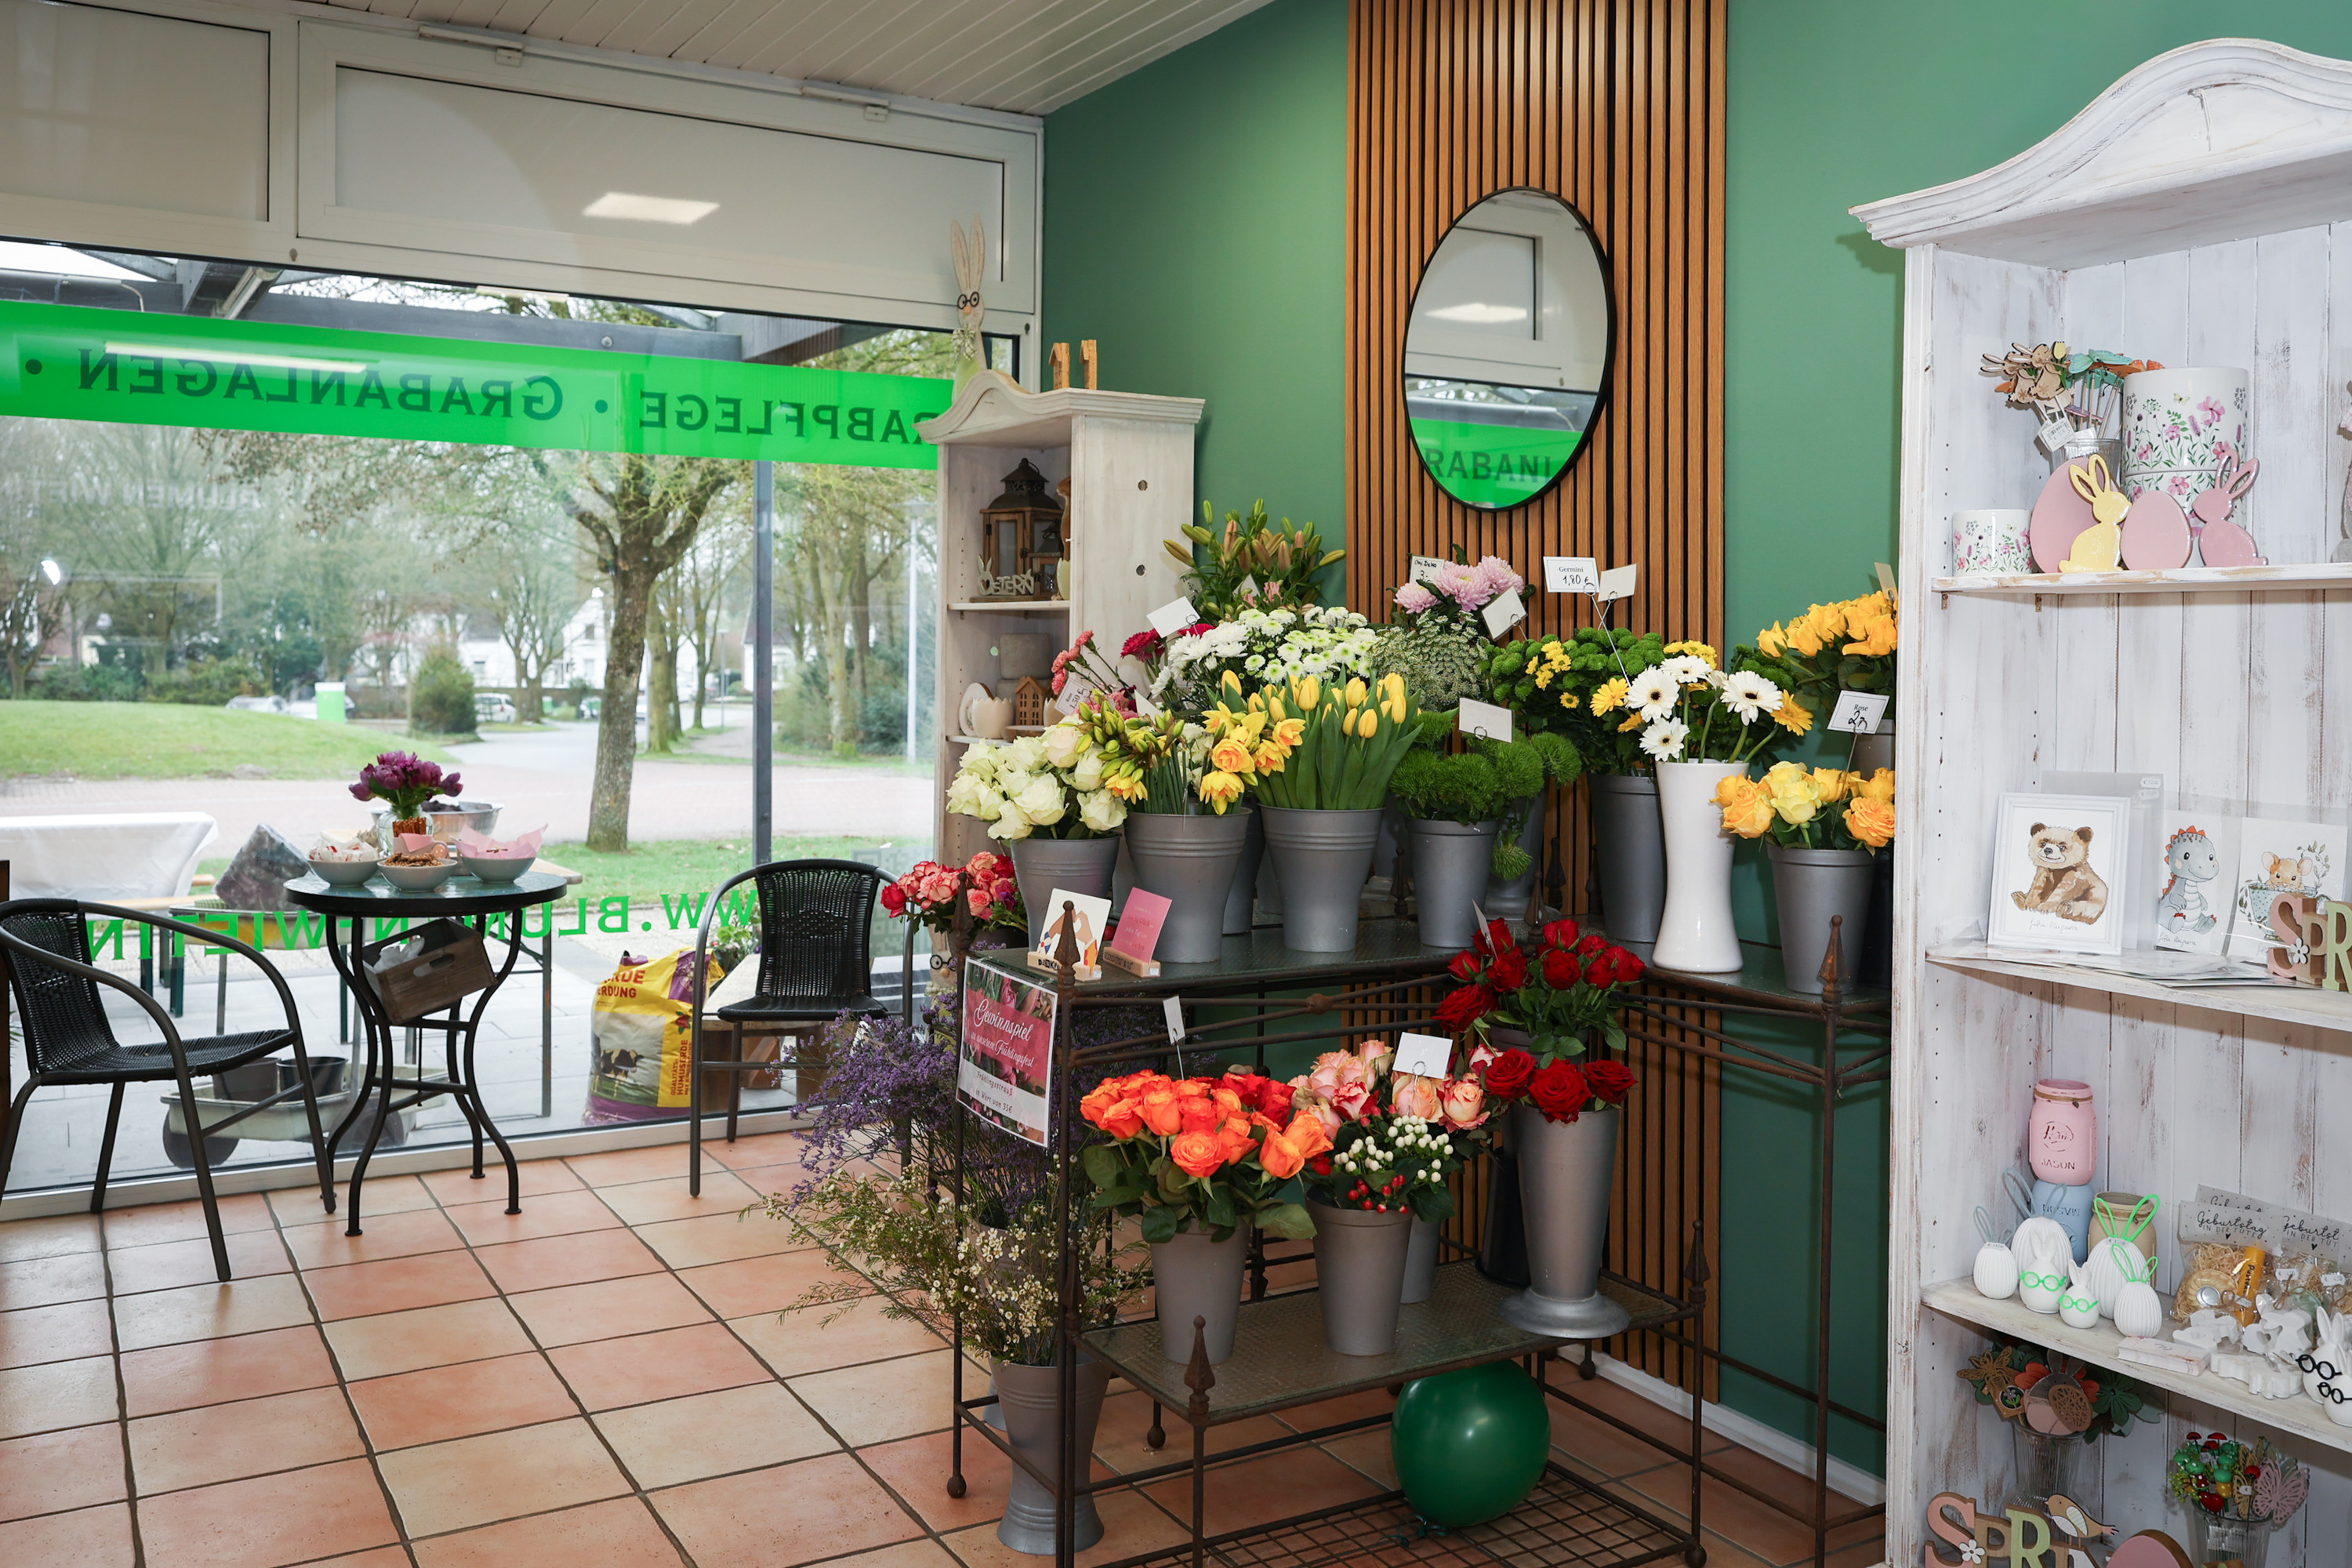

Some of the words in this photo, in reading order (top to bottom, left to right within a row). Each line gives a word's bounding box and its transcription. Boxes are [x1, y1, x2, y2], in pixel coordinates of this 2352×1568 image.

[978, 564, 1034, 596] OSTERN
[1563, 574, 1581, 586] 1,80
[974, 999, 1033, 1041] Gewinnspiel
[677, 1040, 688, 1095] HUMUSERDE
[994, 1040, 1035, 1068] Frühlingsfest
[993, 1100, 1001, 1109] von
[1003, 1103, 1013, 1114] 35€
[2198, 1211, 2267, 1239] Geburtstag
[2301, 1233, 2315, 1242] DER
